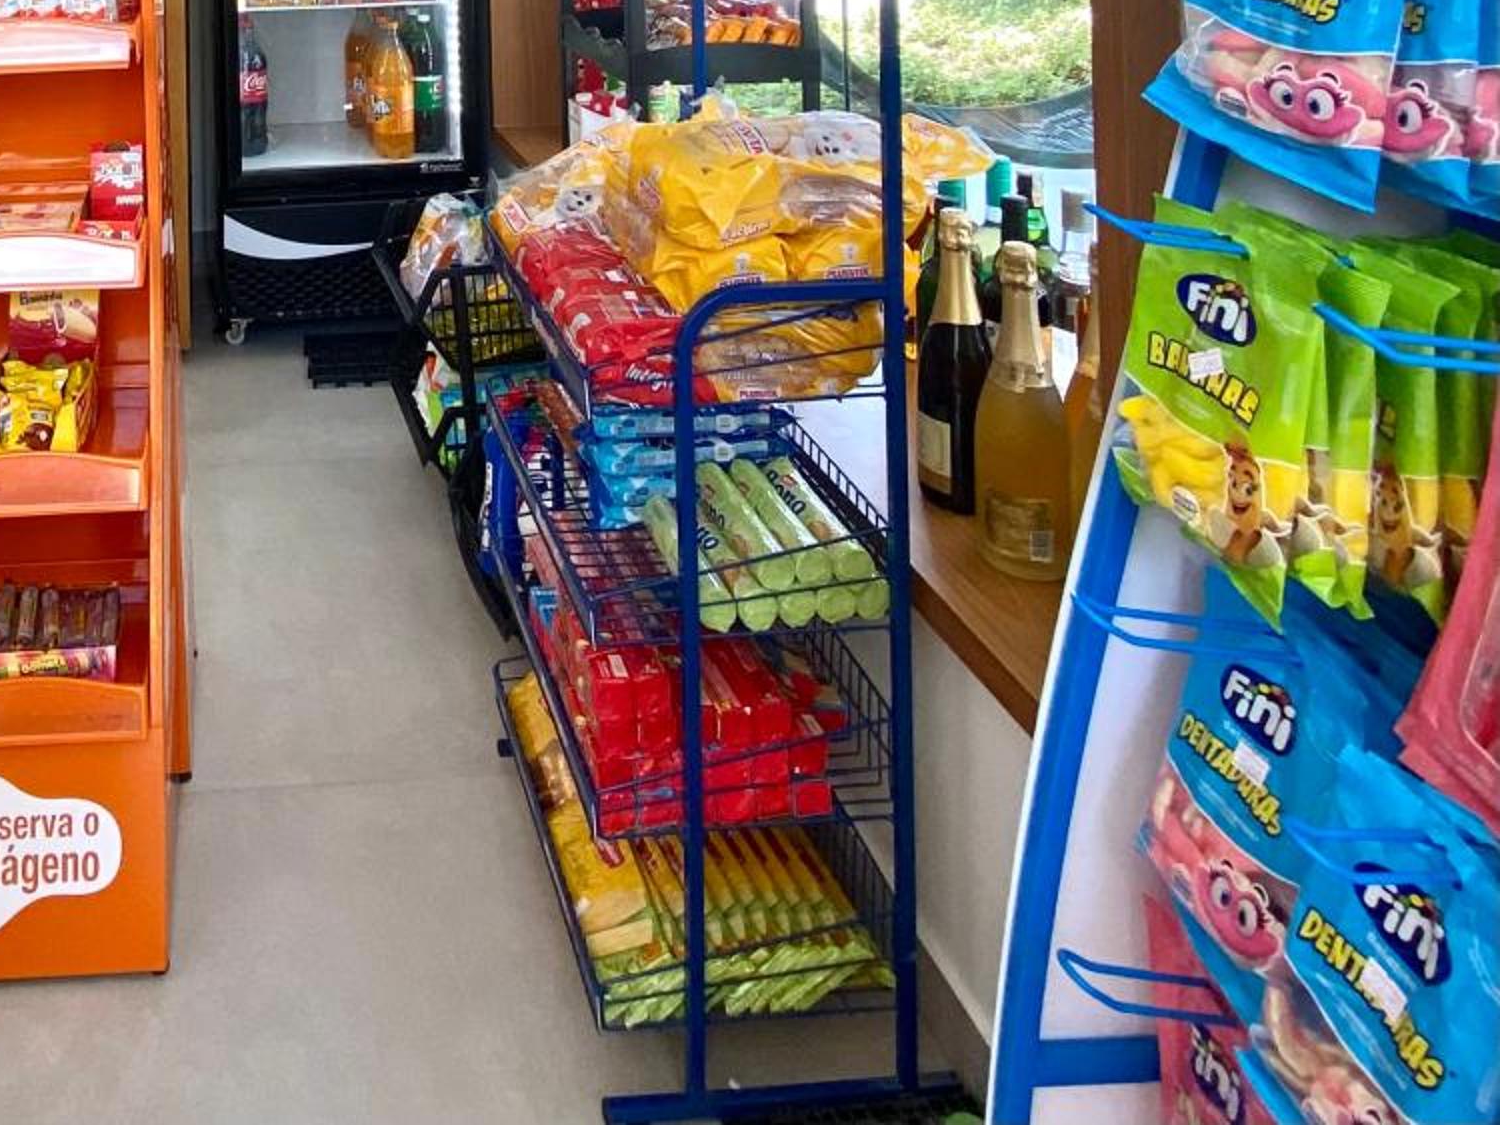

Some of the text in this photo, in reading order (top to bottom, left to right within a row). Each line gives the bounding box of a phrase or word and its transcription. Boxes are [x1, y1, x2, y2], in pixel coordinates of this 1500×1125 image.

[1187, 281, 1250, 343] Fini
[1223, 670, 1297, 752] Fini
[83, 811, 100, 837] o
[1363, 884, 1445, 980] Fini
[1298, 908, 1444, 1088] DENTRAS
